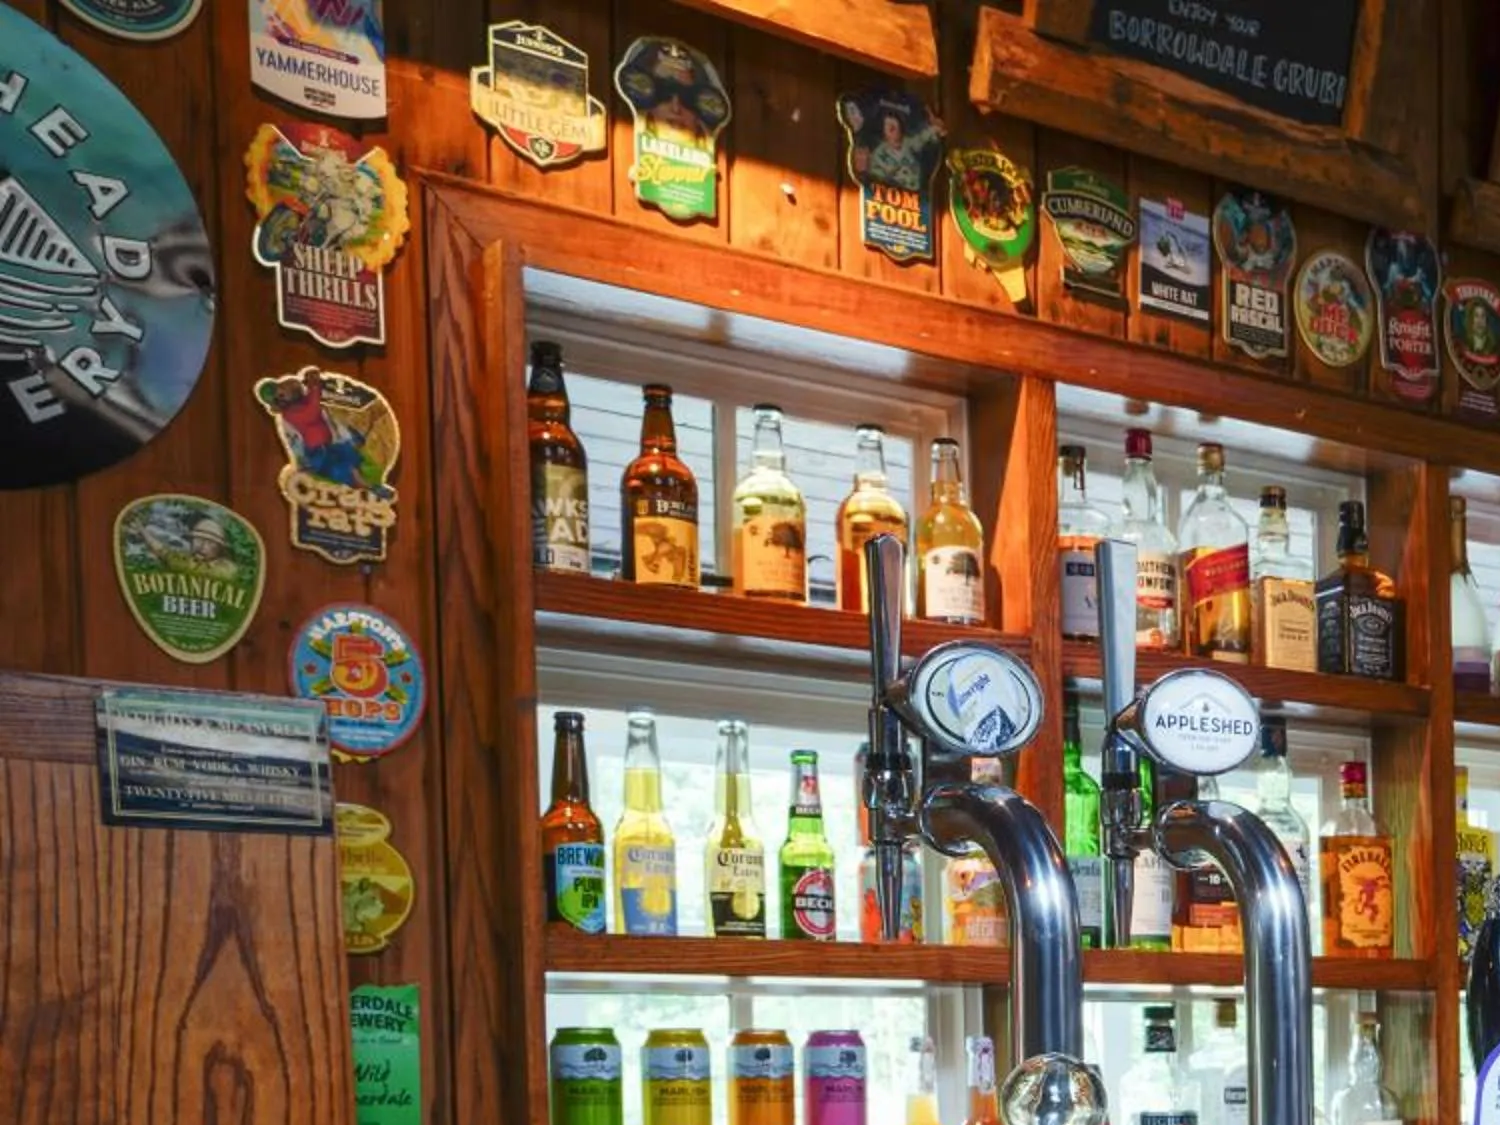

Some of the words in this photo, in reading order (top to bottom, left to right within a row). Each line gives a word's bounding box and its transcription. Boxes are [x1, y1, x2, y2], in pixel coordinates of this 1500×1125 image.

[1223, 11, 1261, 37] YOUR
[1109, 10, 1268, 90] BORROWDALE
[256, 48, 382, 97] YAMMERHOUSE
[494, 102, 546, 134] LITTLE
[549, 119, 586, 142] GEM
[871, 183, 921, 212] TOM
[865, 200, 927, 234] FOOL
[1048, 197, 1134, 239] CUMBERLAND
[293, 241, 364, 280] SHEEP
[284, 267, 378, 310] THRILLS
[1151, 281, 1179, 300] WHITE
[1235, 283, 1281, 315] RED
[1231, 307, 1284, 334] RASCAL
[132, 572, 247, 609] BOTANICAL
[162, 595, 218, 619] BEER
[330, 633, 390, 699] 5
[1155, 714, 1254, 737] APPLESHED
[717, 850, 764, 867] Corona
